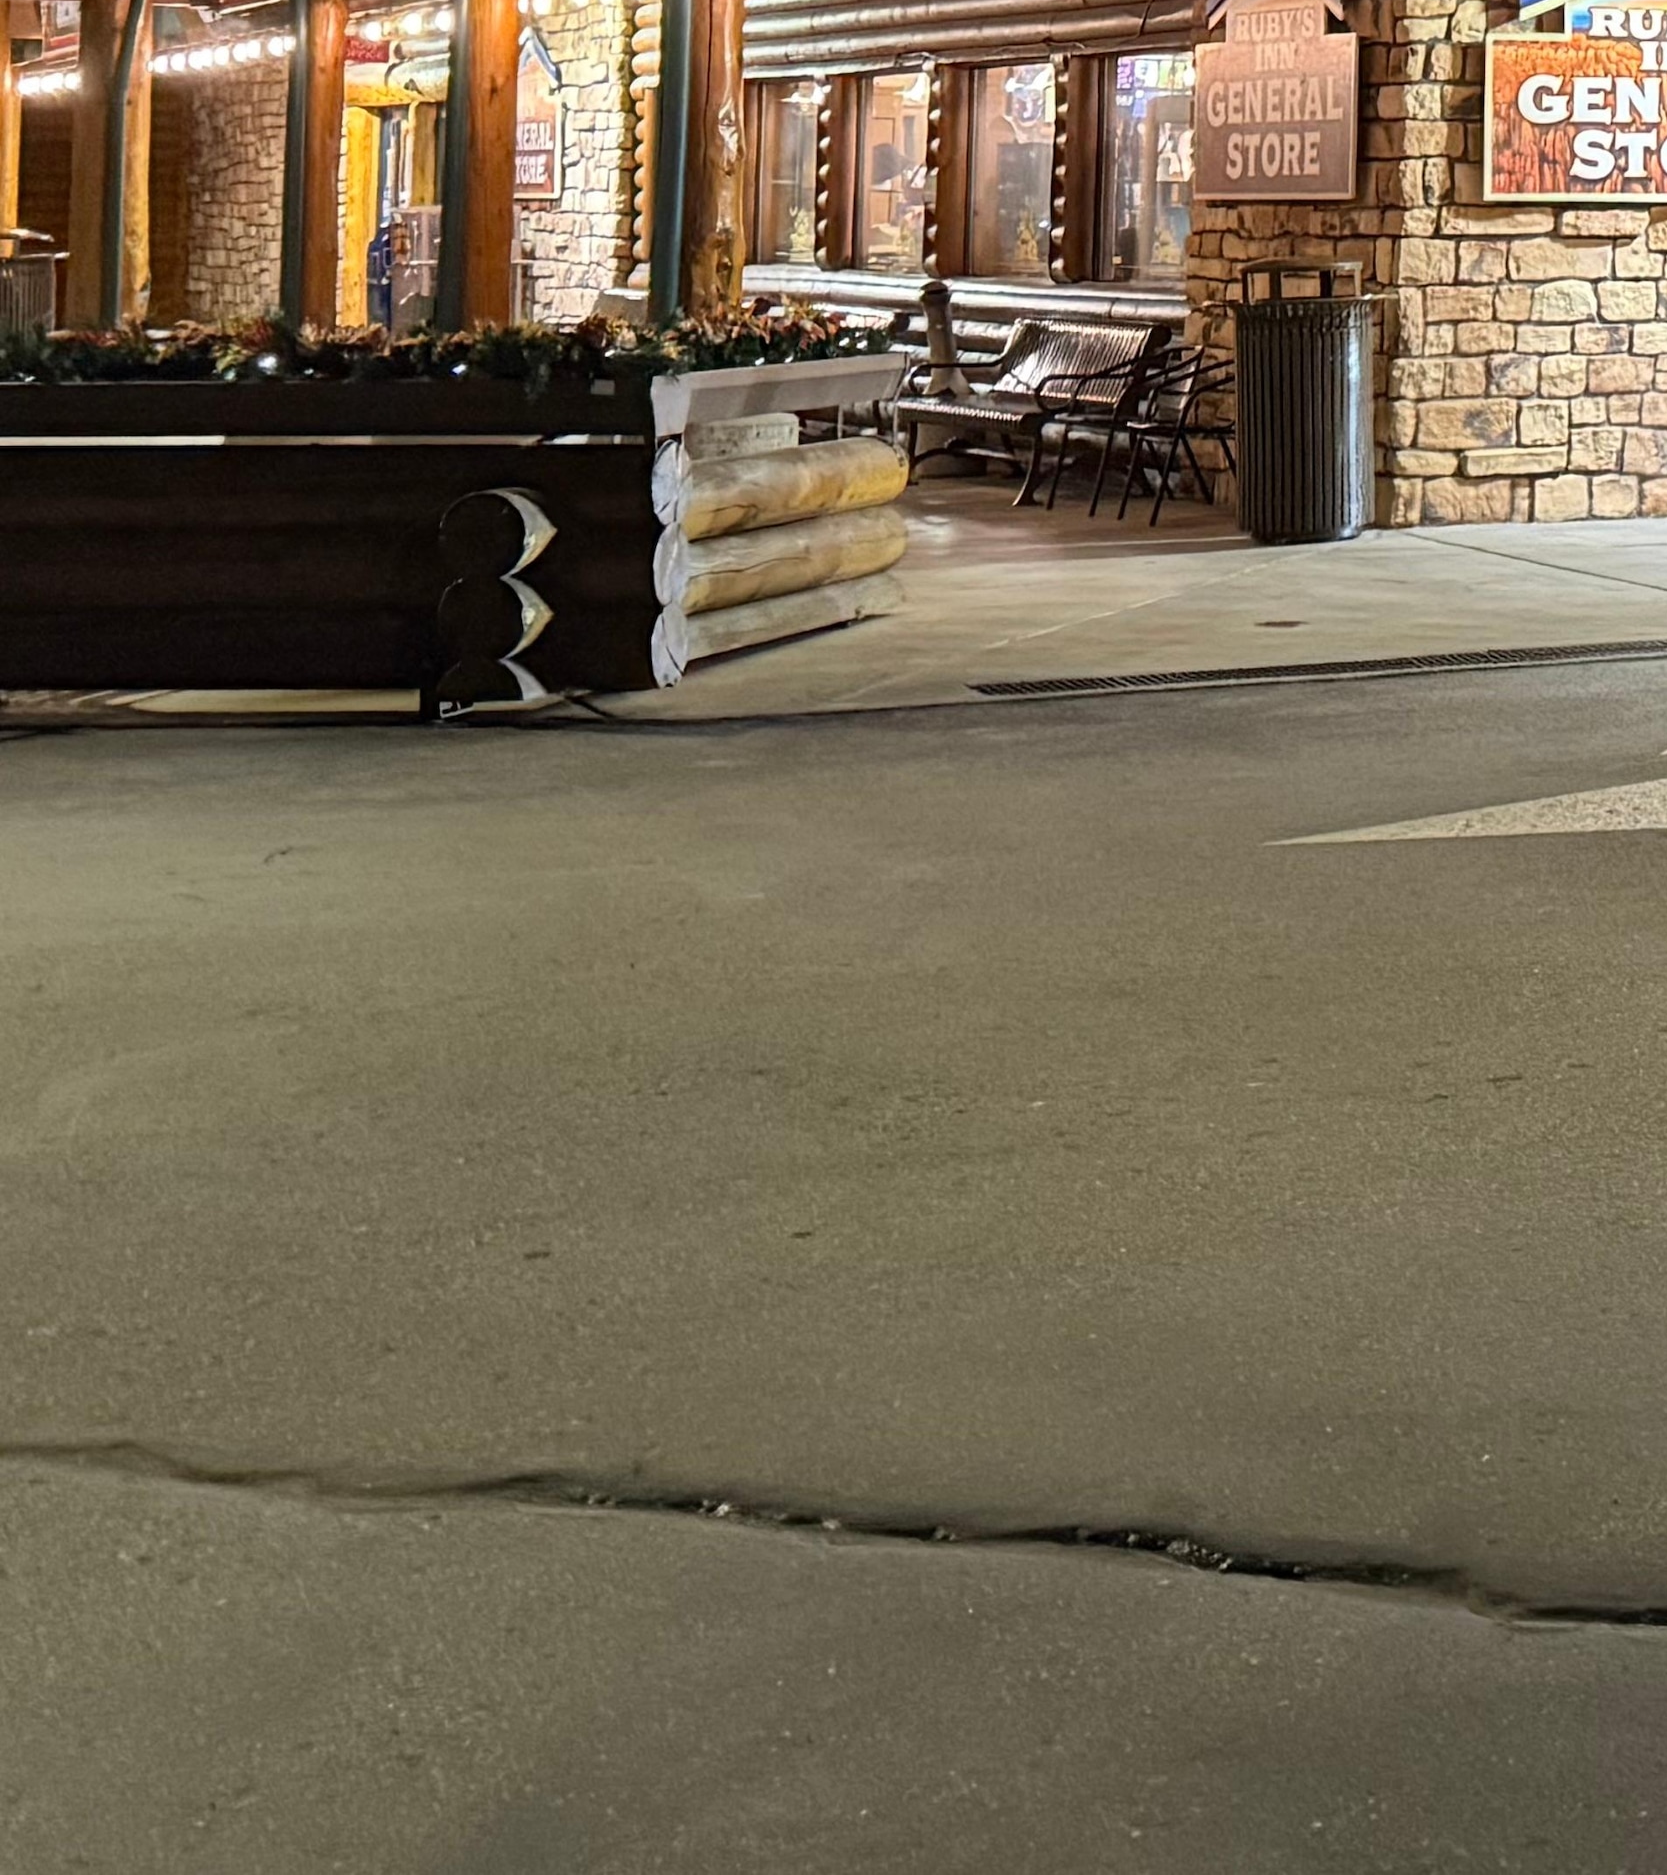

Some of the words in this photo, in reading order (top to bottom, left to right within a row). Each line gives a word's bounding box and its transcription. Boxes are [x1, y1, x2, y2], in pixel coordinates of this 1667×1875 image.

[1235, 8, 1317, 42] RUBY'S
[1253, 42, 1297, 73] INN
[1207, 78, 1345, 128] GENERAL
[515, 154, 550, 186] TORE
[1224, 130, 1321, 181] STORE
